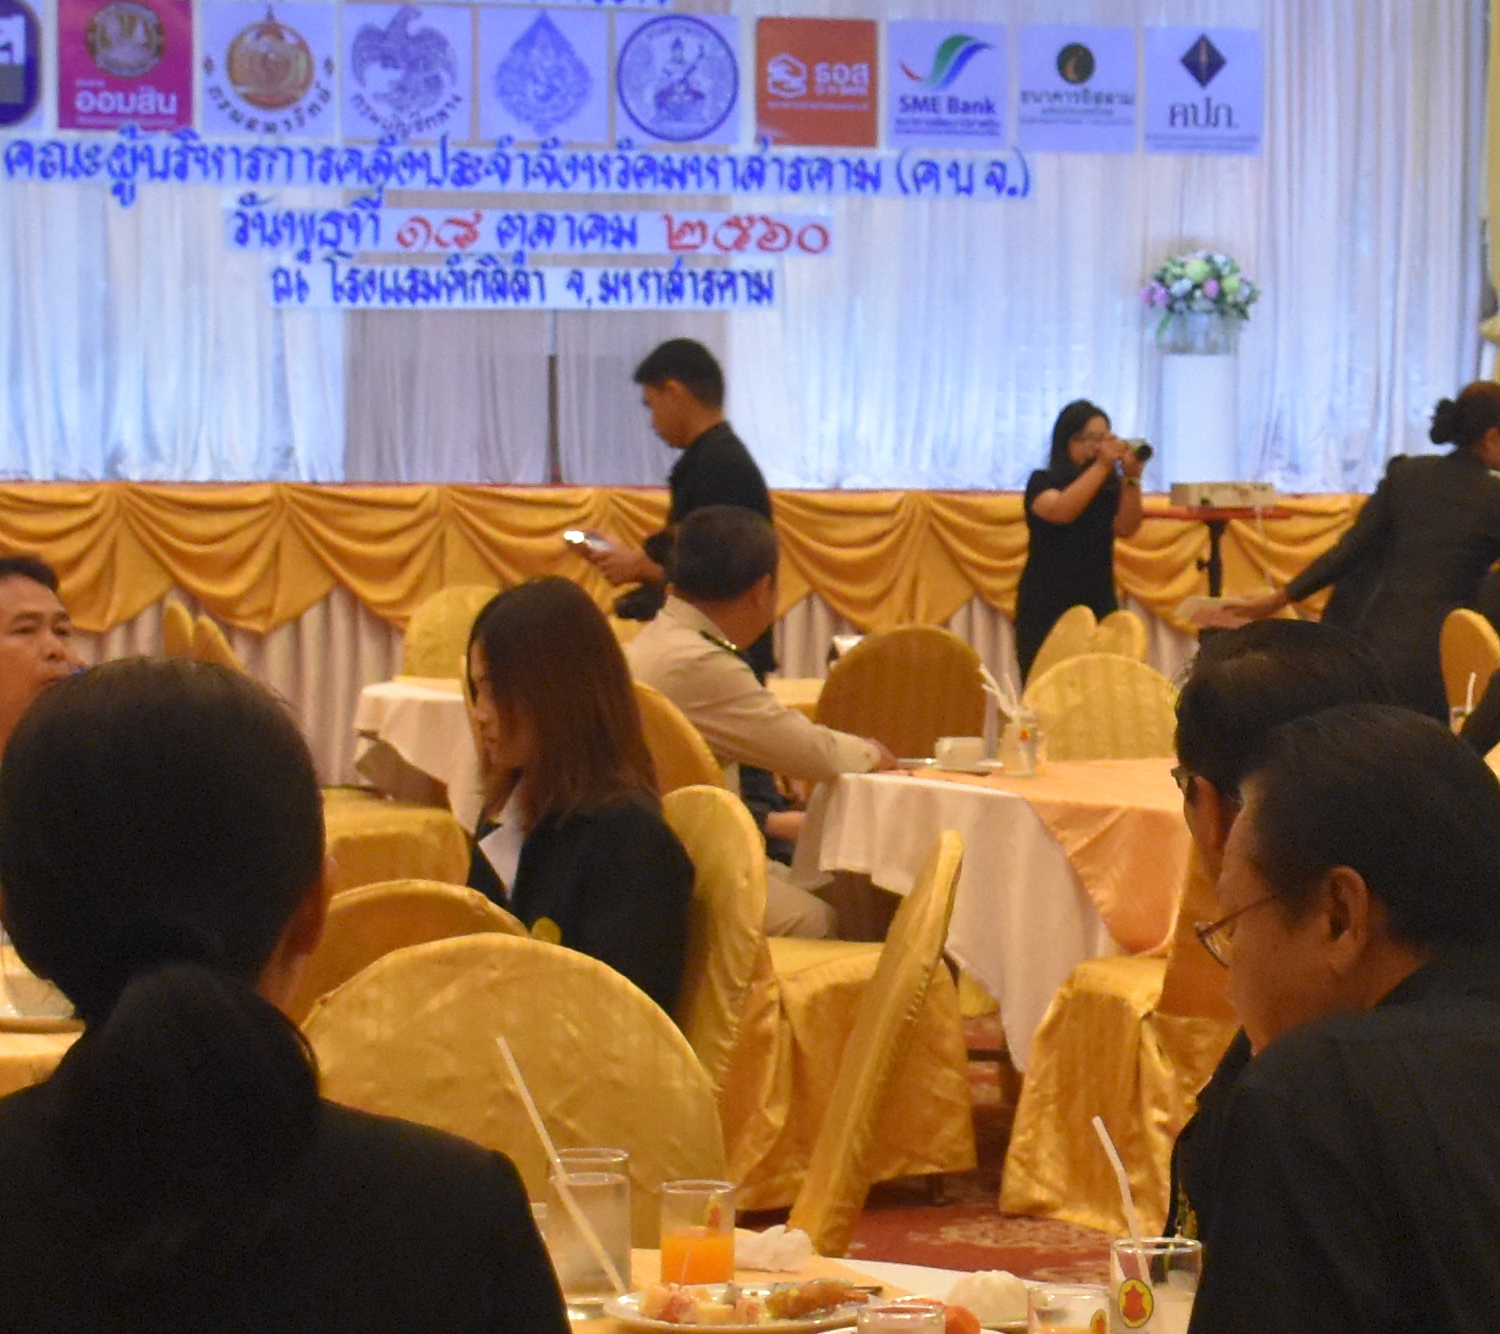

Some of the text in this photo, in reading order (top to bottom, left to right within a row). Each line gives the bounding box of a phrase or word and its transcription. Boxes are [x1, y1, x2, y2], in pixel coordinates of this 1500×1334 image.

[74, 84, 179, 115] ออมสิน
[899, 94, 997, 114] SME Bank
[233, 184, 383, 264] วันพุธที่
[662, 212, 832, 255] ๒๕๖๐
